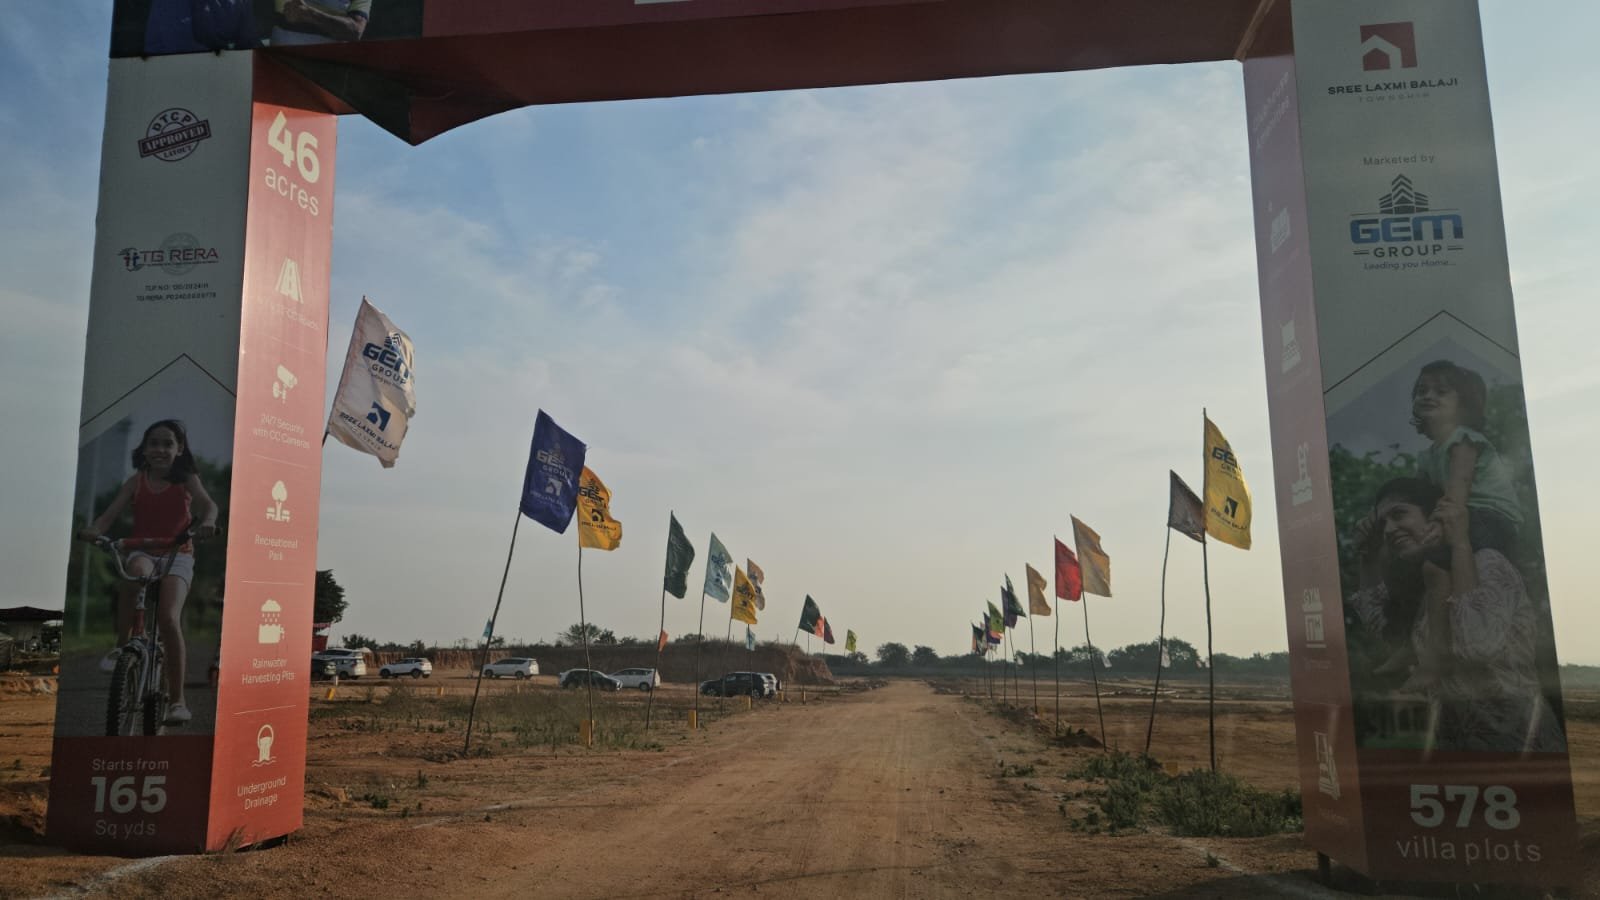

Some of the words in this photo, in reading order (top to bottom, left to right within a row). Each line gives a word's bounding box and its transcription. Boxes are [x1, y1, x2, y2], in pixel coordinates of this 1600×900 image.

[1328, 85, 1362, 95] SREE
[1366, 82, 1407, 92] LAXMI
[1410, 78, 1458, 89] BALAJI
[151, 111, 192, 132] DTCP
[144, 124, 205, 152] APPROVED
[267, 110, 321, 184] 46
[1363, 154, 1417, 166] Marketed
[1421, 154, 1435, 164] by
[264, 167, 319, 217] acres
[1350, 214, 1464, 244] GEM
[169, 247, 219, 261] RERA
[1373, 244, 1443, 258] GROUP
[1364, 261, 1400, 271] Leading
[1402, 261, 1419, 270] you
[254, 533, 298, 549] Recreational
[269, 551, 283, 561] Park
[252, 657, 288, 669] Rainwater
[241, 671, 281, 685] Harvesting
[281, 670, 295, 681] Pits
[92, 758, 133, 772] Starts
[136, 757, 169, 771] from
[91, 775, 168, 814] 165
[237, 775, 287, 798] Underground
[244, 792, 278, 810] Drainage
[1410, 783, 1521, 830] 578
[95, 819, 117, 839] Sq
[124, 819, 156, 839] yds
[1396, 835, 1457, 860] villa
[1464, 838, 1542, 865] plots
